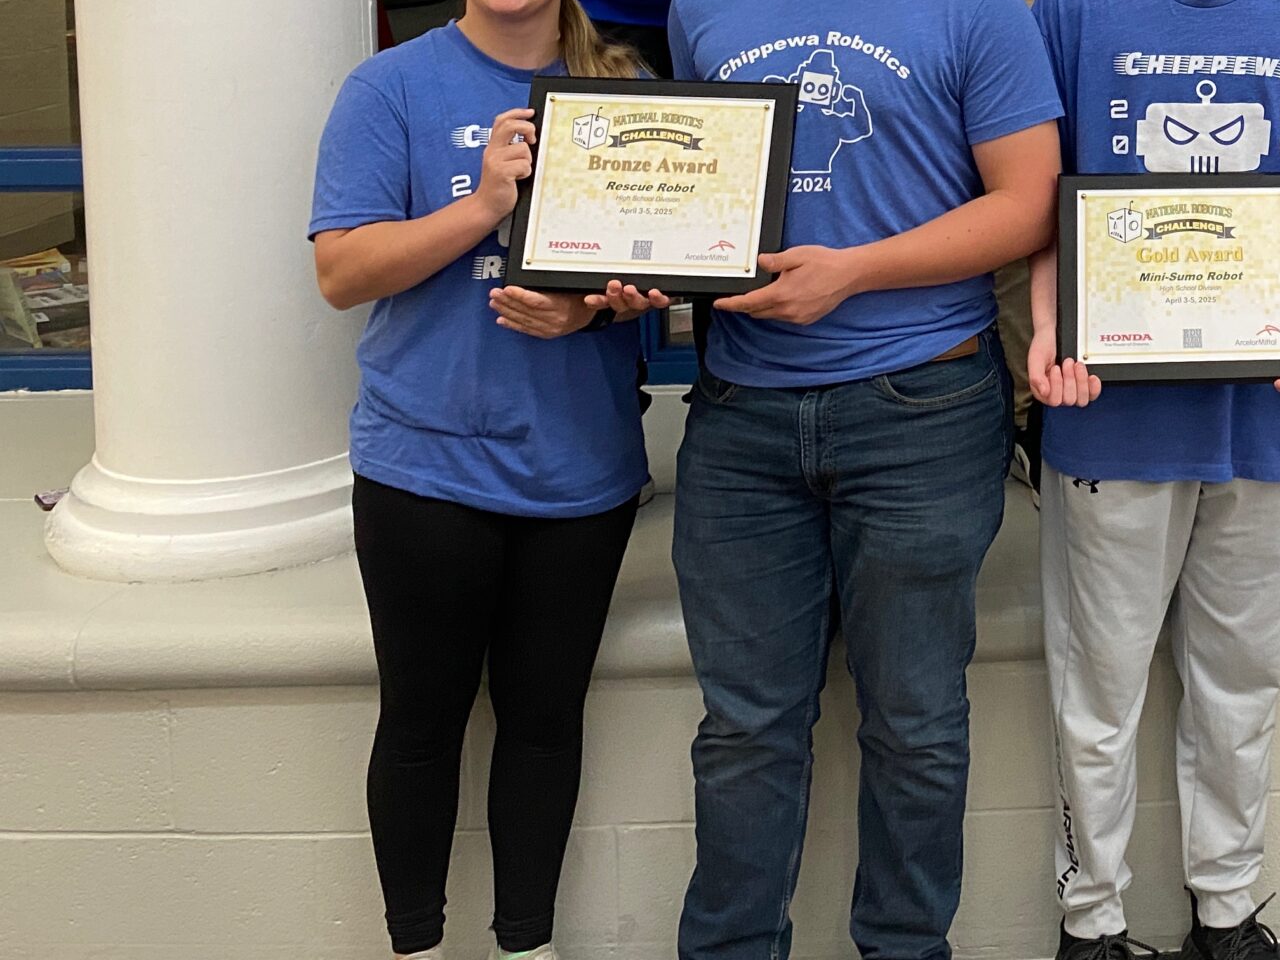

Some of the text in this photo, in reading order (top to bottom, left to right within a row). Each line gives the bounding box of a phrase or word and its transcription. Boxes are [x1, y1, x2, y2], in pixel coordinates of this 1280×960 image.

[719, 31, 911, 80] Chippewa Robotics
[1110, 99, 1128, 119] 2
[613, 112, 704, 129] NATIONAL ROBOTICS
[621, 130, 691, 143] CHALLENGE
[1112, 135, 1129, 154] 0
[588, 155, 718, 174] Bronze Award
[451, 174, 472, 197] 2
[606, 181, 695, 193] Rescue Robot
[792, 177, 832, 193] 2024
[619, 208, 637, 216] April
[1146, 203, 1233, 219] NATIONAL ROBOTICS
[1156, 220, 1224, 234] CHALLENGE
[548, 241, 602, 250] HONDA
[684, 253, 728, 262] ArcelorMittal
[1136, 246, 1243, 263] Gold Award
[1139, 271, 1243, 282] Mini-Sumo Robot
[1165, 297, 1182, 305] April
[1198, 296, 1217, 304] 2025
[1100, 334, 1152, 342] HONDA
